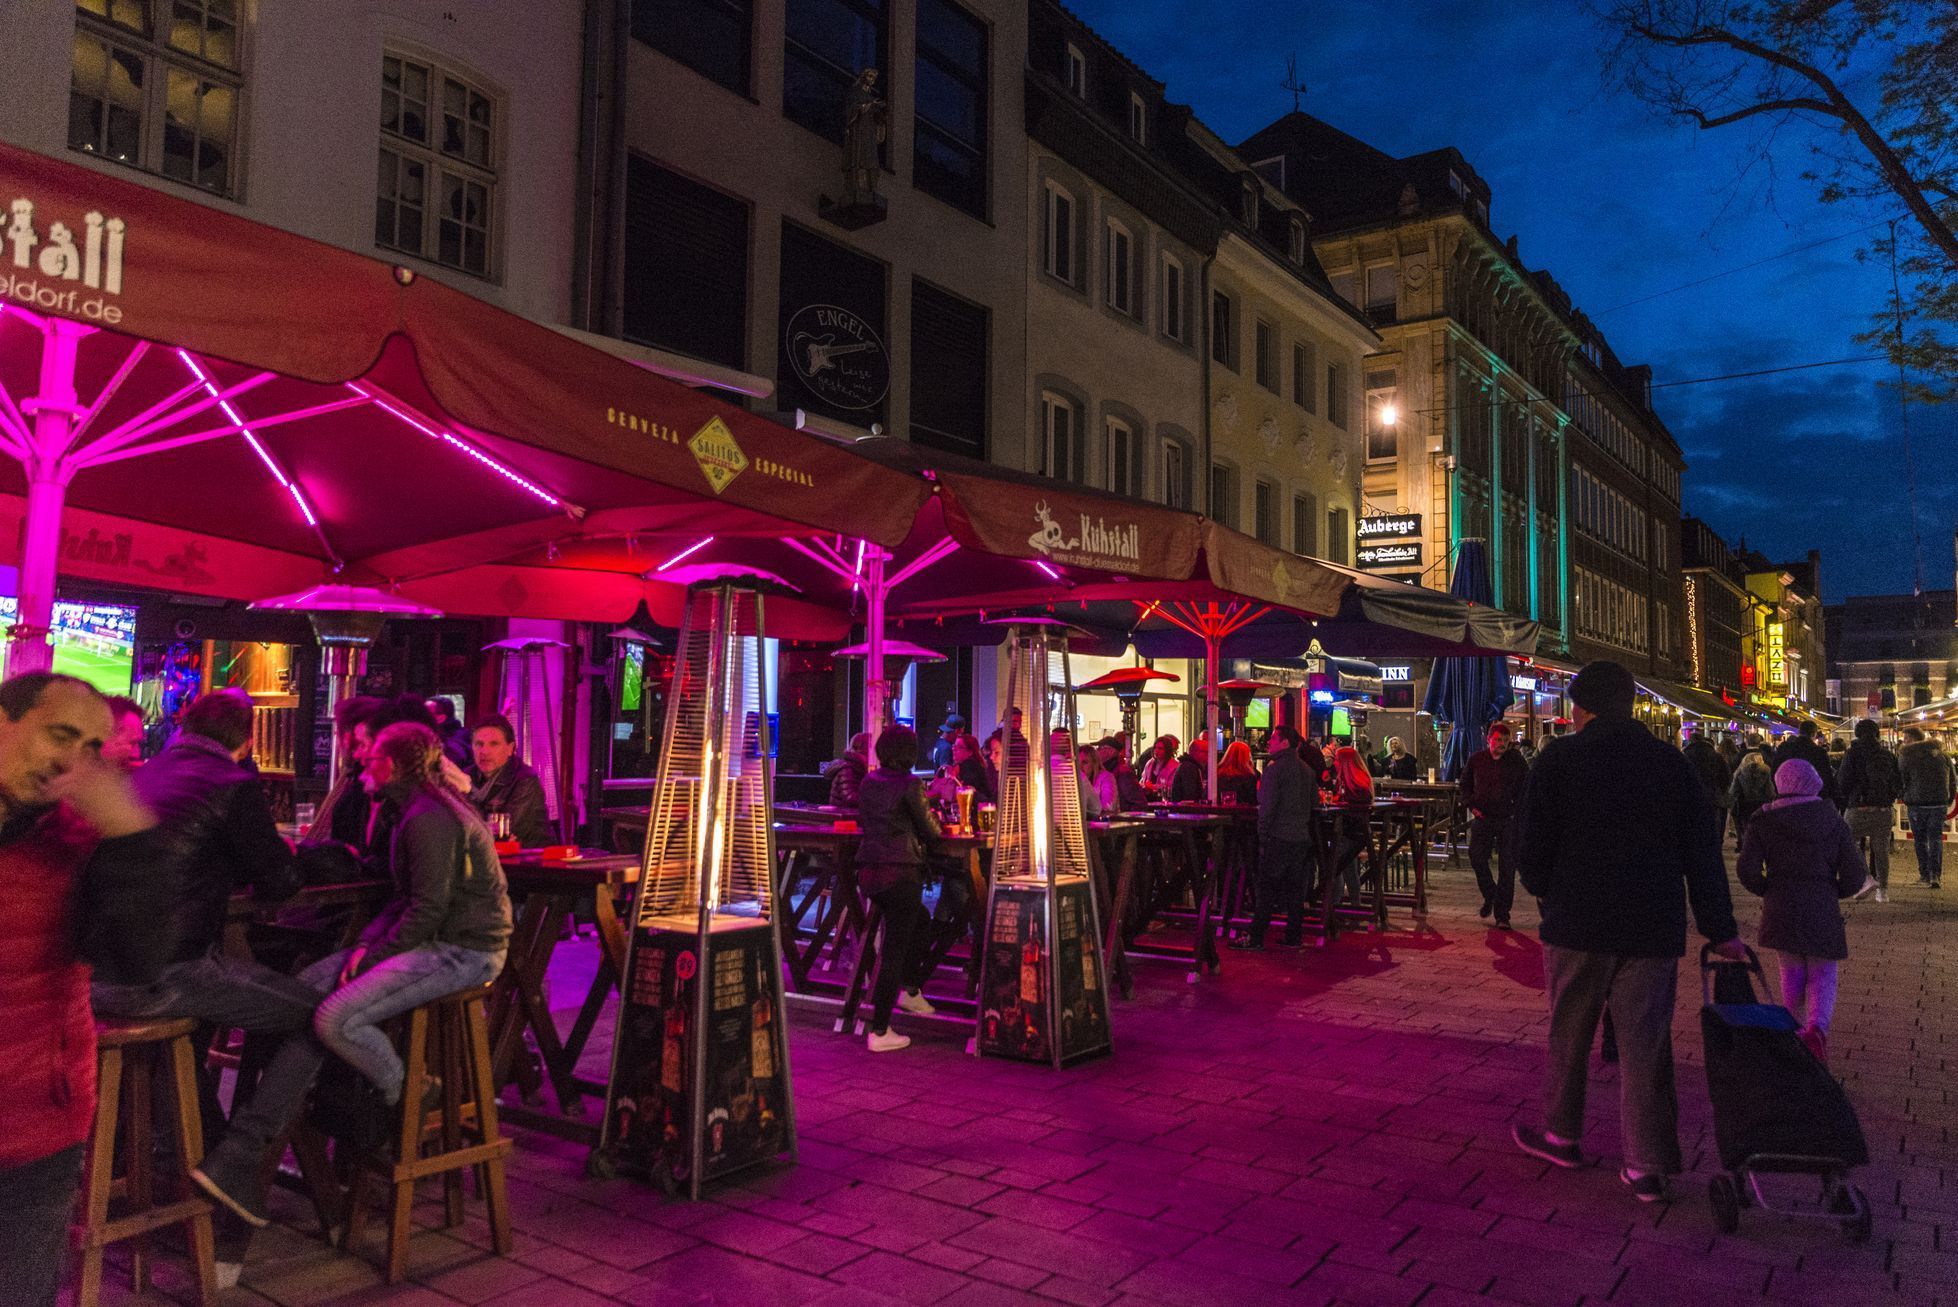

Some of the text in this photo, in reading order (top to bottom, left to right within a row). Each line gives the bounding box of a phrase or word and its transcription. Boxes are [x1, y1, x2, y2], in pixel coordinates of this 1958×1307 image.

[816, 310, 864, 341] ENGEL
[607, 407, 680, 445] CERVEZA
[697, 439, 741, 465] SALITOS
[755, 457, 815, 488] ESPECIAL
[1357, 519, 1416, 537] Auberge
